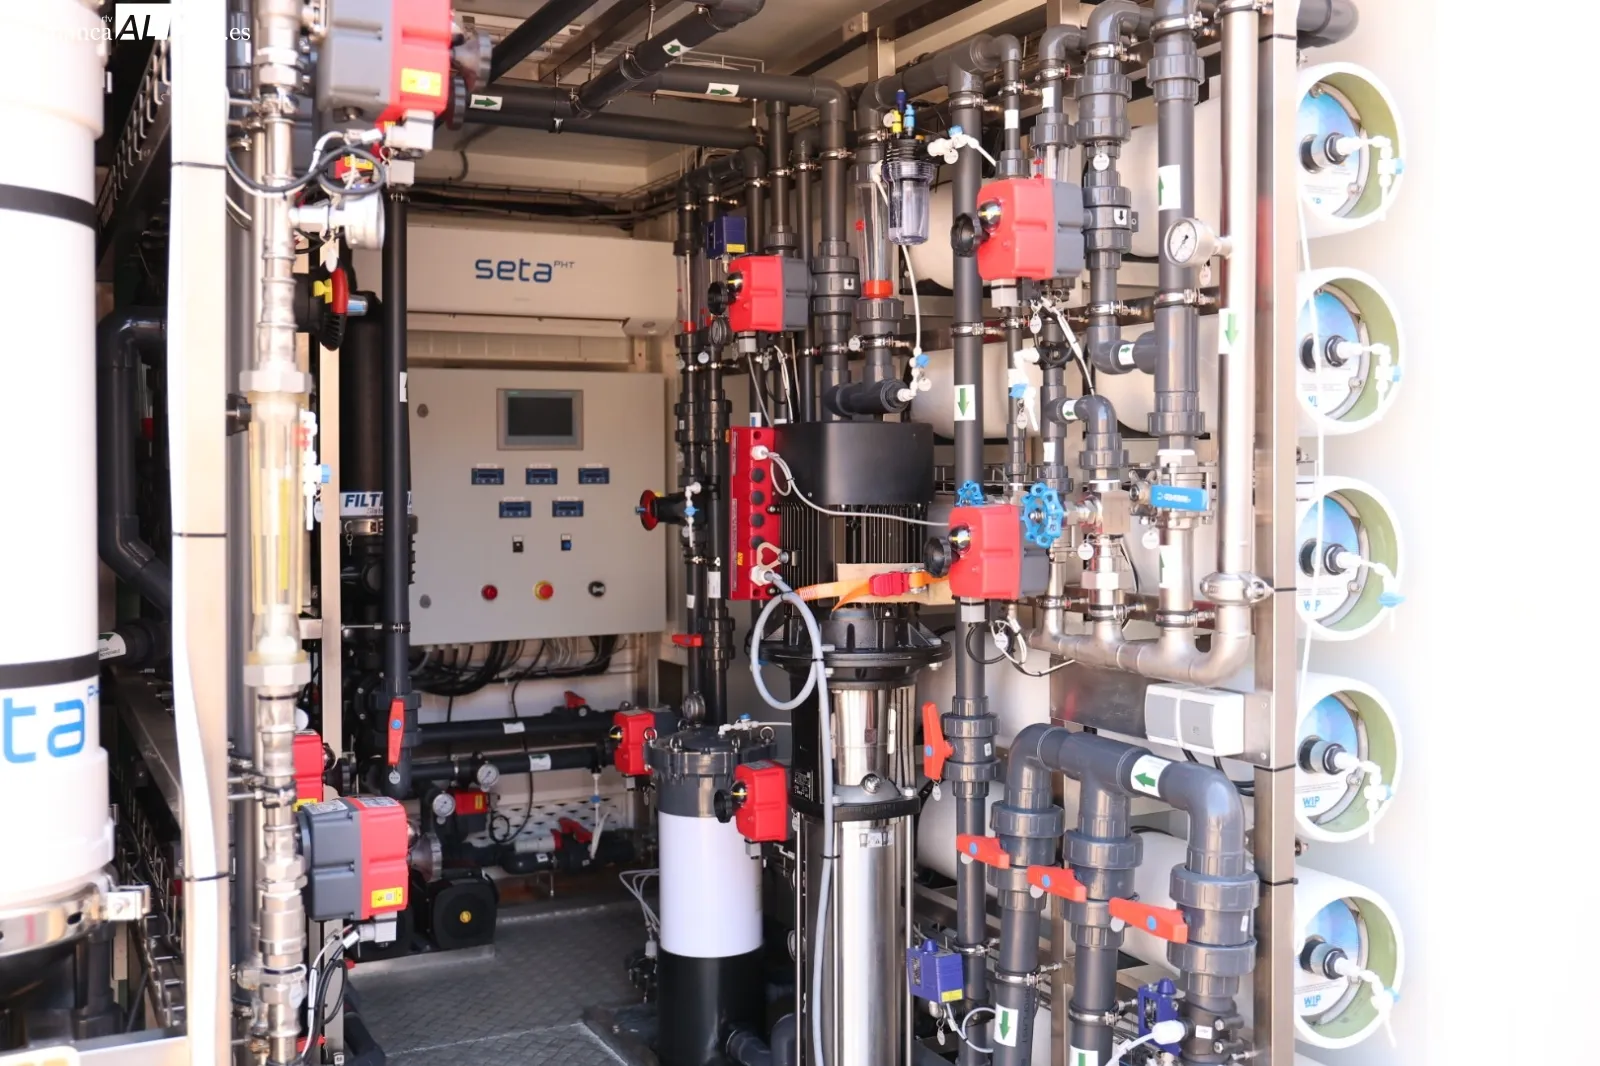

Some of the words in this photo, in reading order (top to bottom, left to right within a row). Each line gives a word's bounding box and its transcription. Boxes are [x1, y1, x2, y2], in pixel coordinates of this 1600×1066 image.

[475, 258, 552, 283] seta
[554, 260, 575, 268] PHT
[345, 494, 383, 508] FILT
[1303, 796, 1320, 805] WIP
[1304, 995, 1321, 1005] WIP
